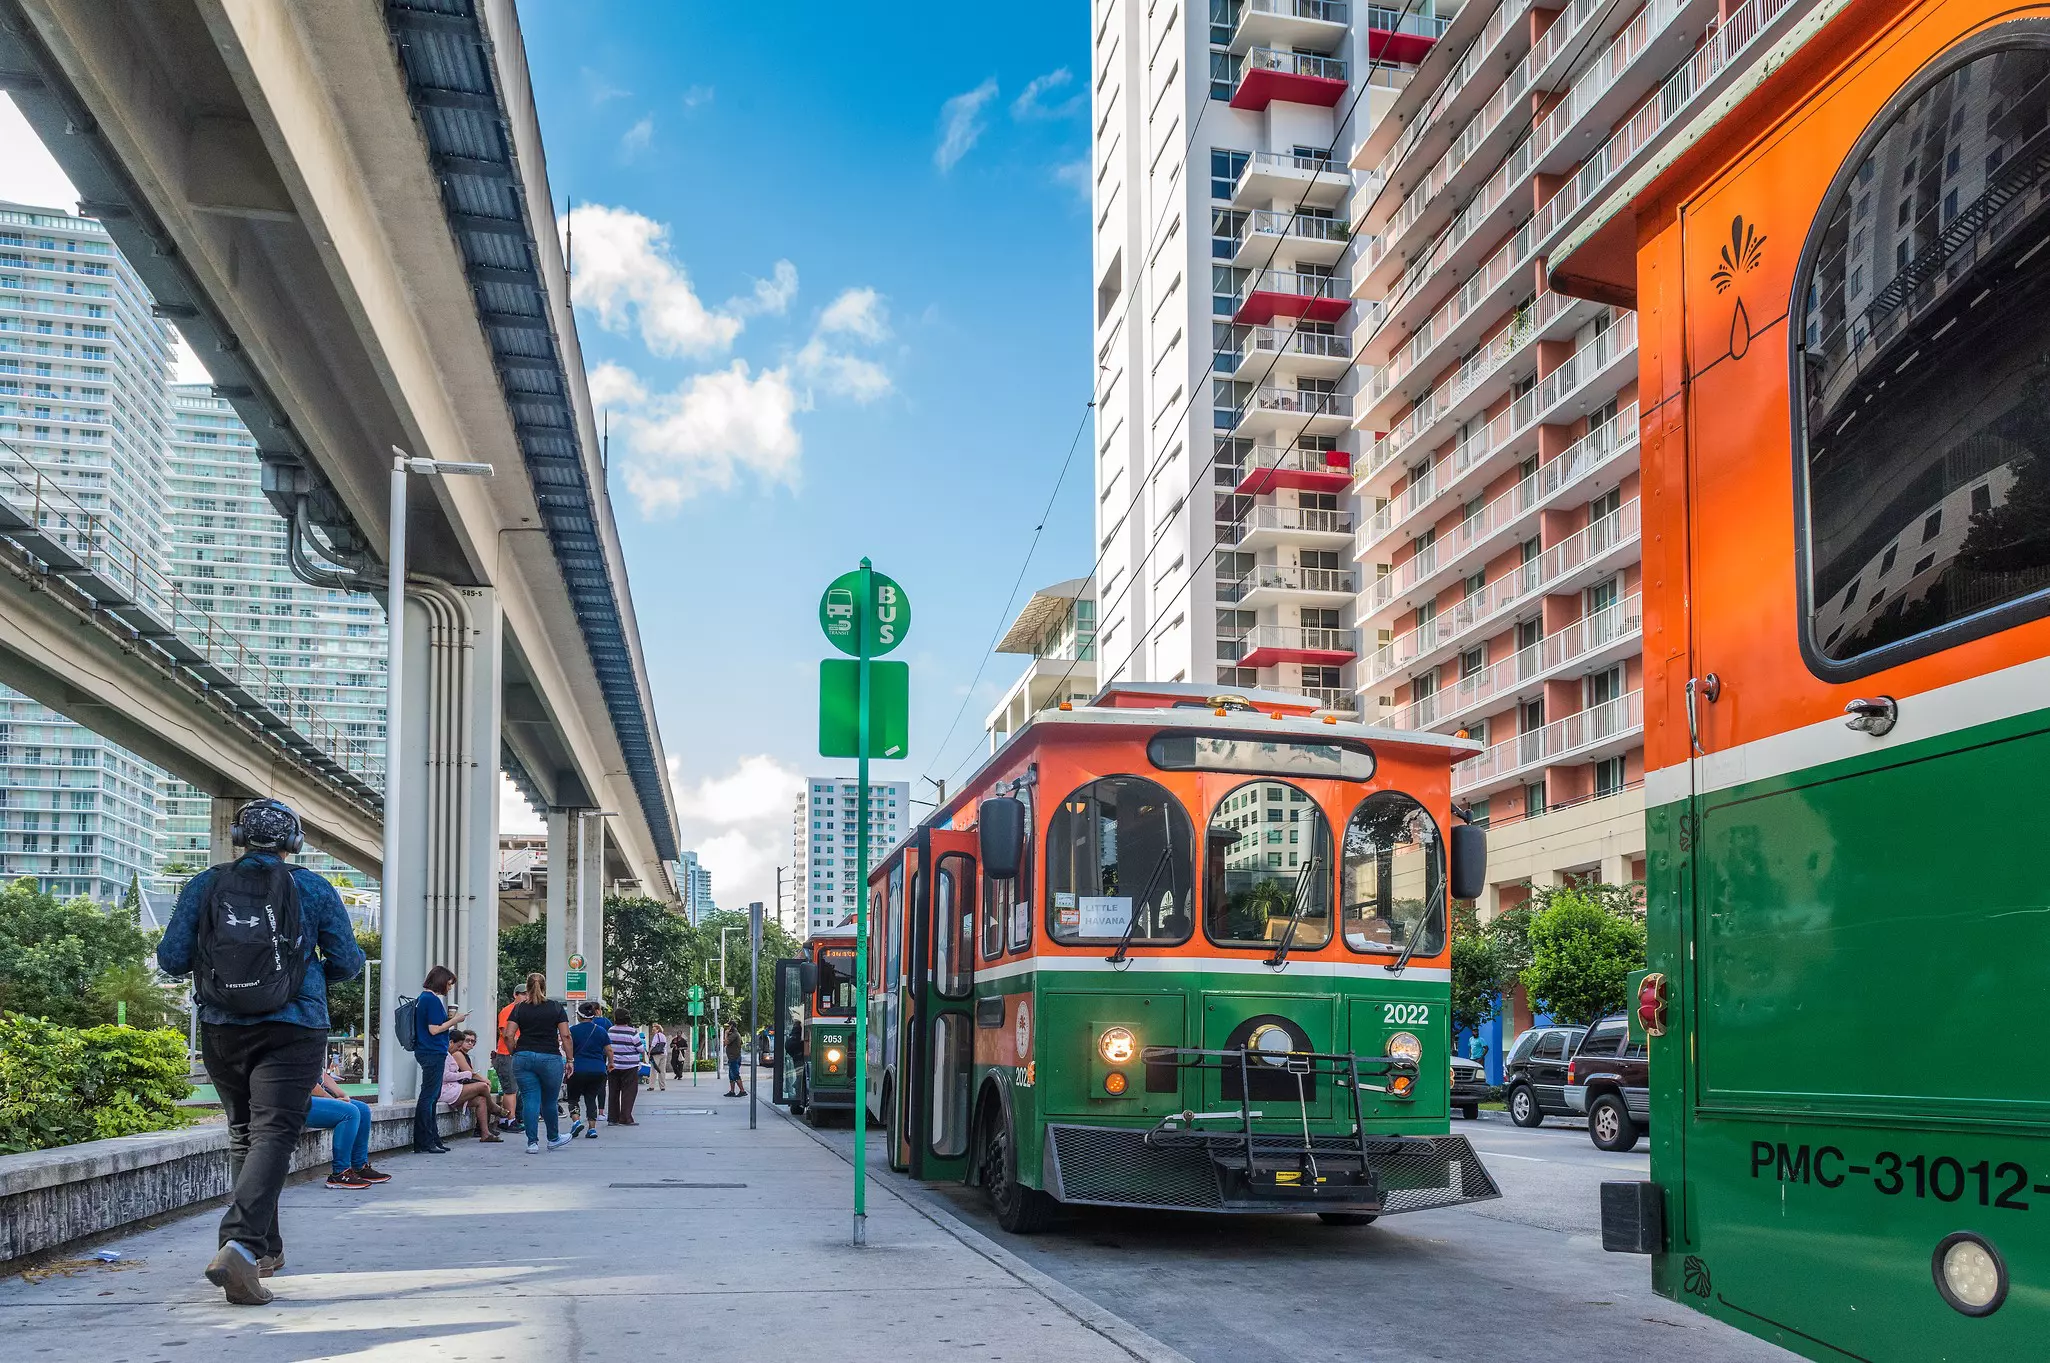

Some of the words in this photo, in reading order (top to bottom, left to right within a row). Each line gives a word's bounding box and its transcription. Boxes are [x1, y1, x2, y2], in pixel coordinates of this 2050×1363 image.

[878, 585, 897, 644] BUS
[1085, 904, 1118, 912] LITTLE
[1085, 917, 1126, 925] HAVANA
[1383, 1003, 1429, 1025] 2022
[823, 1034, 843, 1043] 2053
[1015, 1066, 1032, 1088] 202
